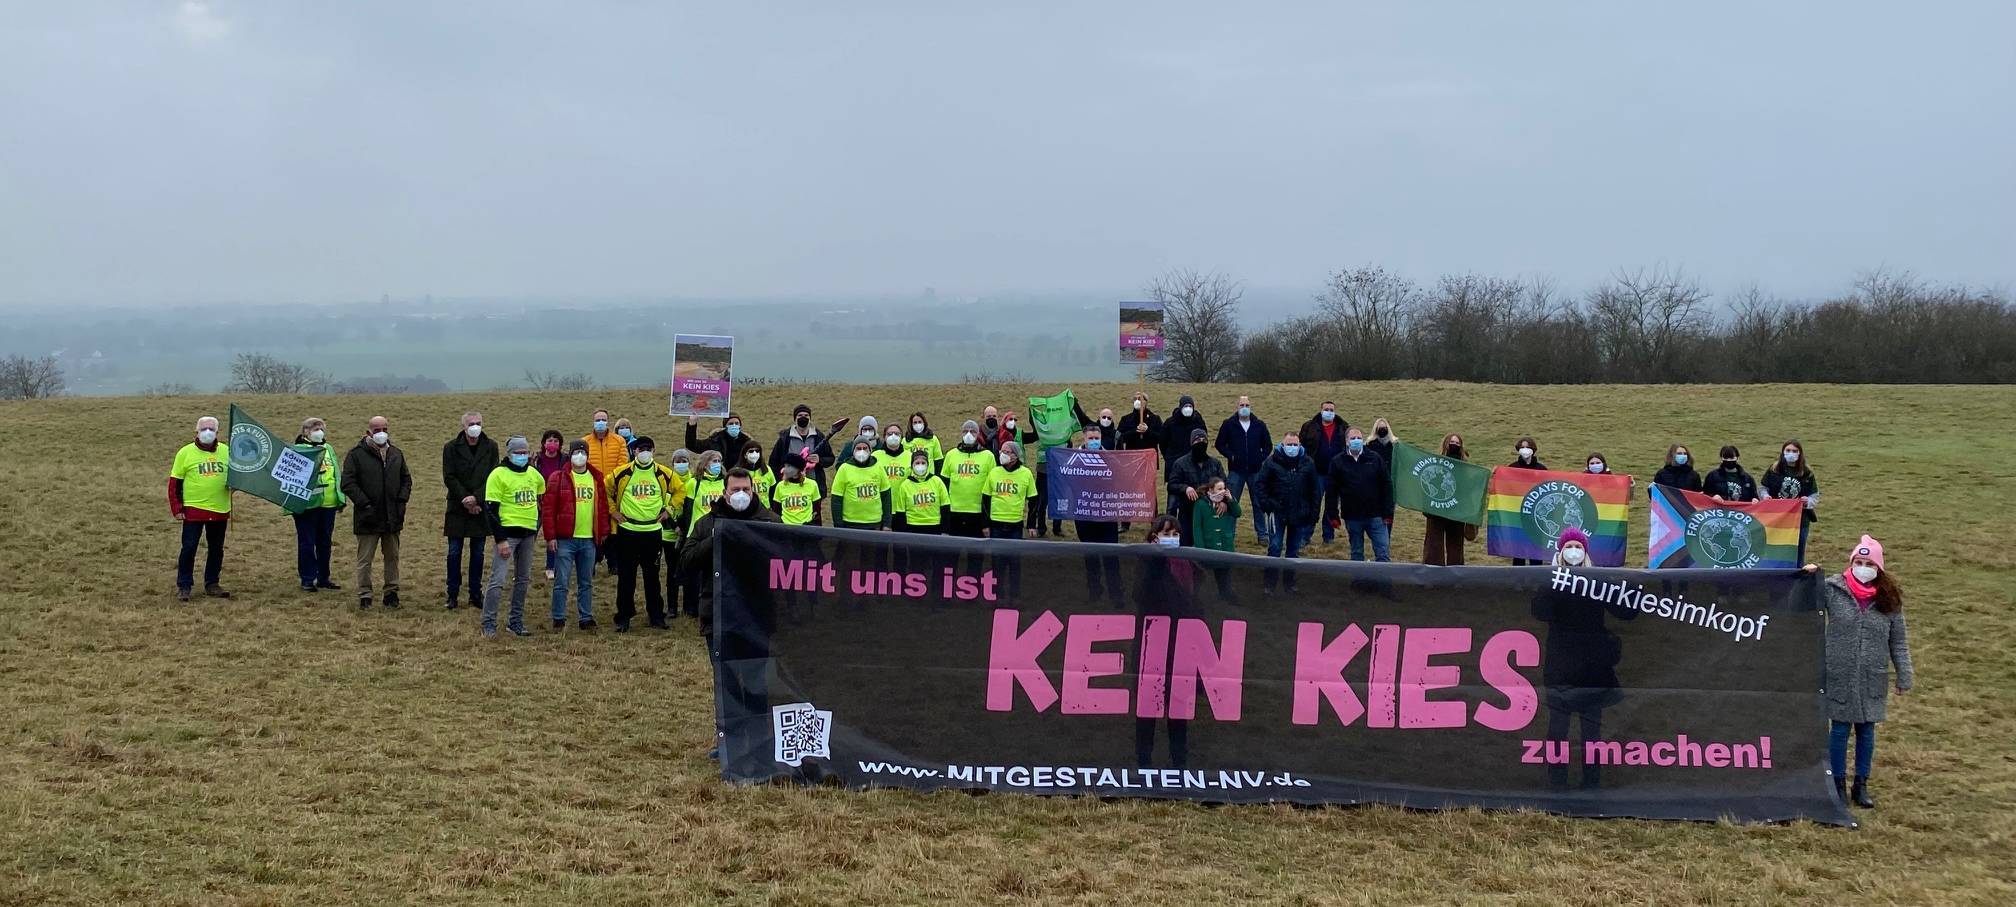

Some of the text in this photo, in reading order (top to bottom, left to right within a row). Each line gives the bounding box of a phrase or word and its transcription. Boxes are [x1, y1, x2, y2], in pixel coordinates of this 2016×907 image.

[199, 461, 224, 474] KIES
[884, 465, 905, 477] KIES
[957, 463, 980, 475] KIES
[1060, 466, 1113, 477] Wattbewerb
[1413, 457, 1454, 476] FRIDAYS FOR
[281, 482, 311, 499] JETZT
[576, 487, 594, 500] IES
[632, 484, 656, 497] KIES
[857, 485, 878, 498] KIES
[996, 482, 1018, 495] KIES
[514, 490, 536, 503] KIES
[784, 495, 808, 507] KIES
[913, 491, 936, 505] KIES
[1522, 481, 1585, 515] FRIDAYS FOR
[1430, 498, 1459, 509] FUTURE
[1074, 507, 1090, 515] Jetzt
[1687, 509, 1753, 537] FRIDAYS FOR
[769, 558, 998, 601] Mit uns ist
[1551, 566, 1770, 643] #nurkiesimkopf
[986, 608, 1542, 732] KEIN KIES
[1521, 734, 1773, 770] zu machen!
[858, 760, 1313, 790] www.MITGESTALTEN-NV.de
